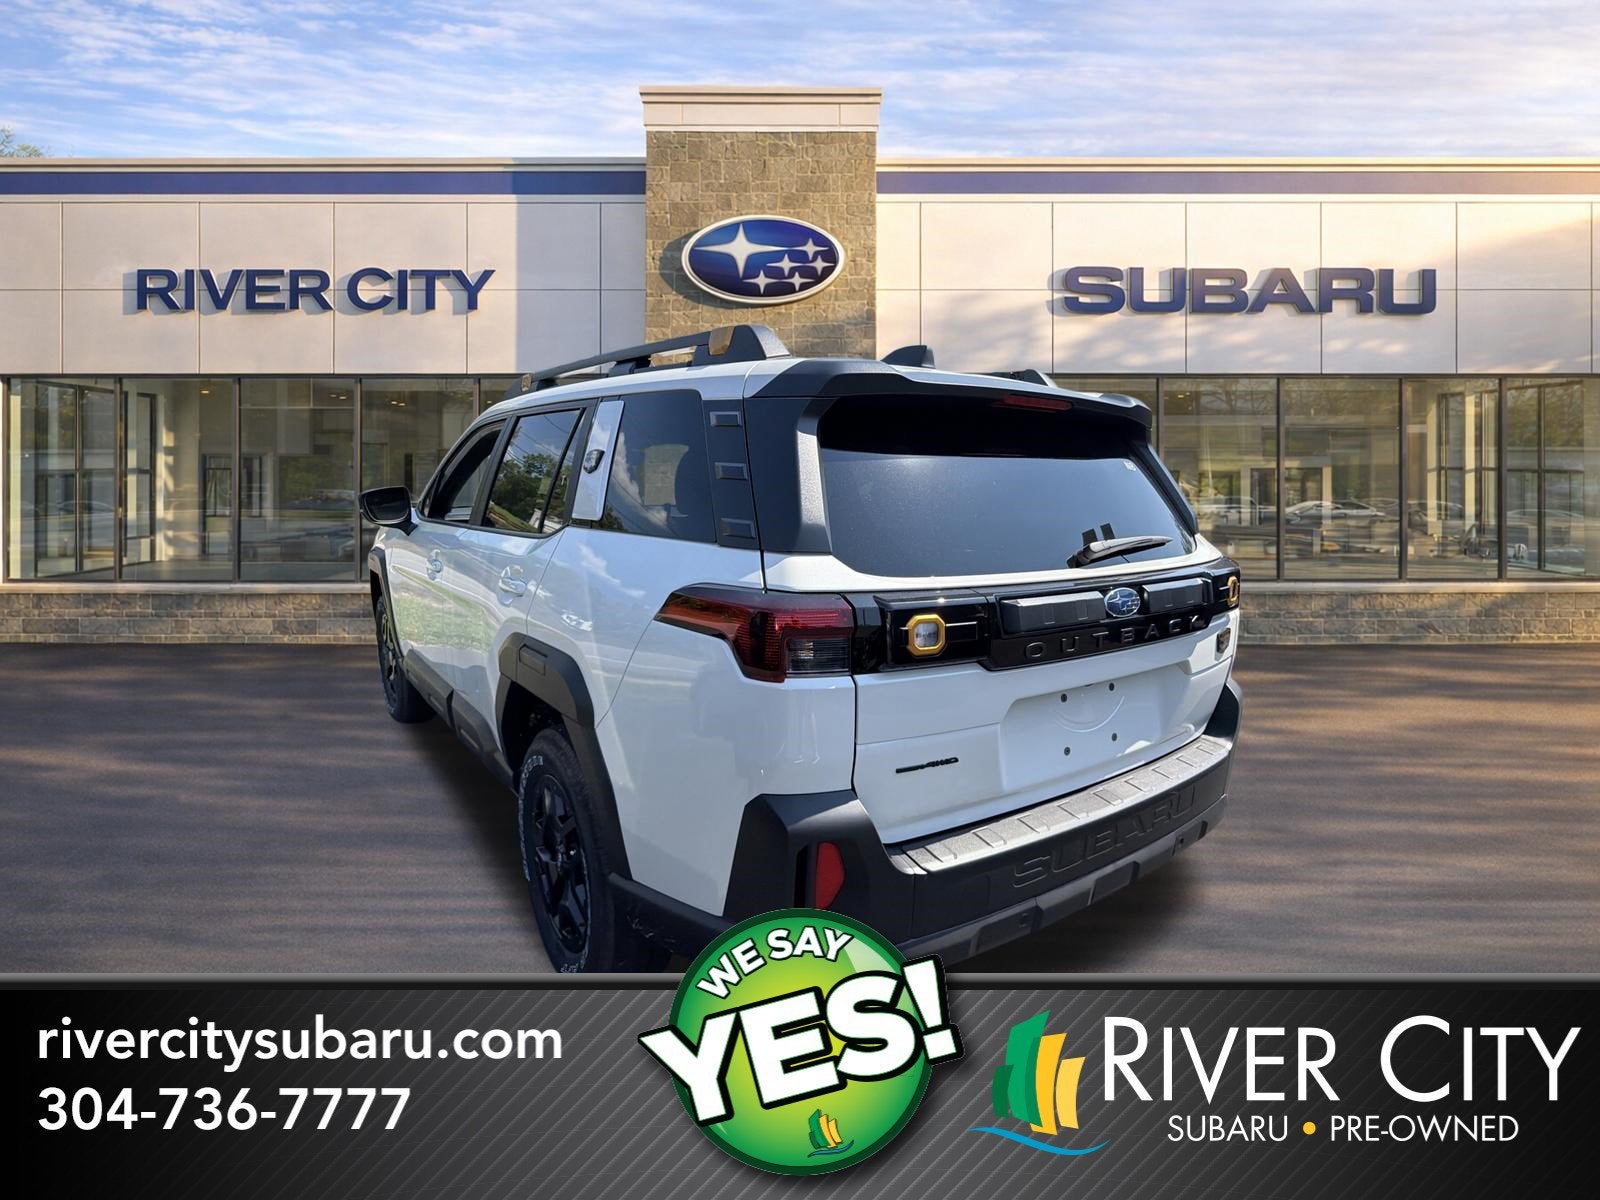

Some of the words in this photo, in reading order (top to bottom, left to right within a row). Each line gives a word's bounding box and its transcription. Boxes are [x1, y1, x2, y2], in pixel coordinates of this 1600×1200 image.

[136, 267, 334, 311] RIVER
[346, 266, 496, 312] CITY
[1062, 266, 1438, 314] SUBARU
[1024, 614, 1205, 660] OUTBACK
[1011, 785, 1197, 889] SUBARU
